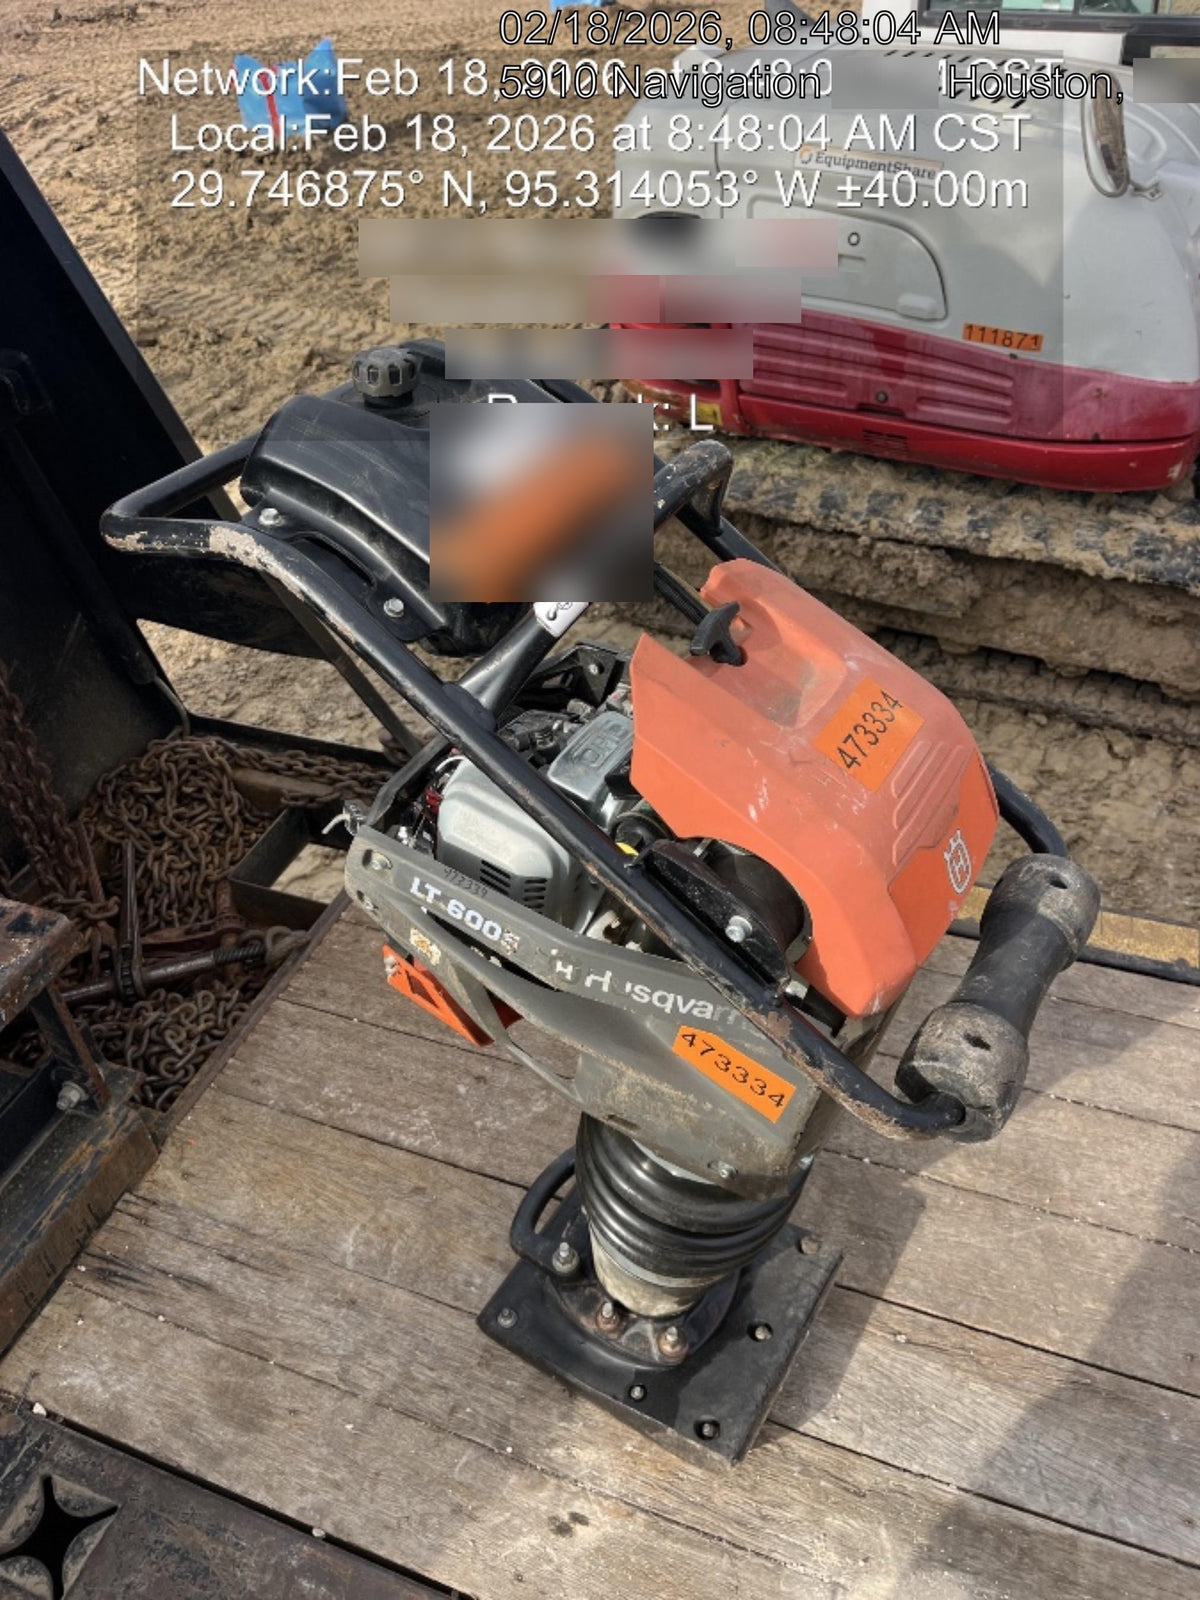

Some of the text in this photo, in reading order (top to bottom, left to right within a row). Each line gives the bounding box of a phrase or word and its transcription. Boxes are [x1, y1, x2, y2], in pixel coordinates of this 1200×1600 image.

[815, 151, 937, 180] EquipmentShare
[965, 323, 1041, 351] 111871
[836, 689, 904, 769] 473334
[410, 876, 442, 904] LT
[681, 1033, 785, 1108] 473334
